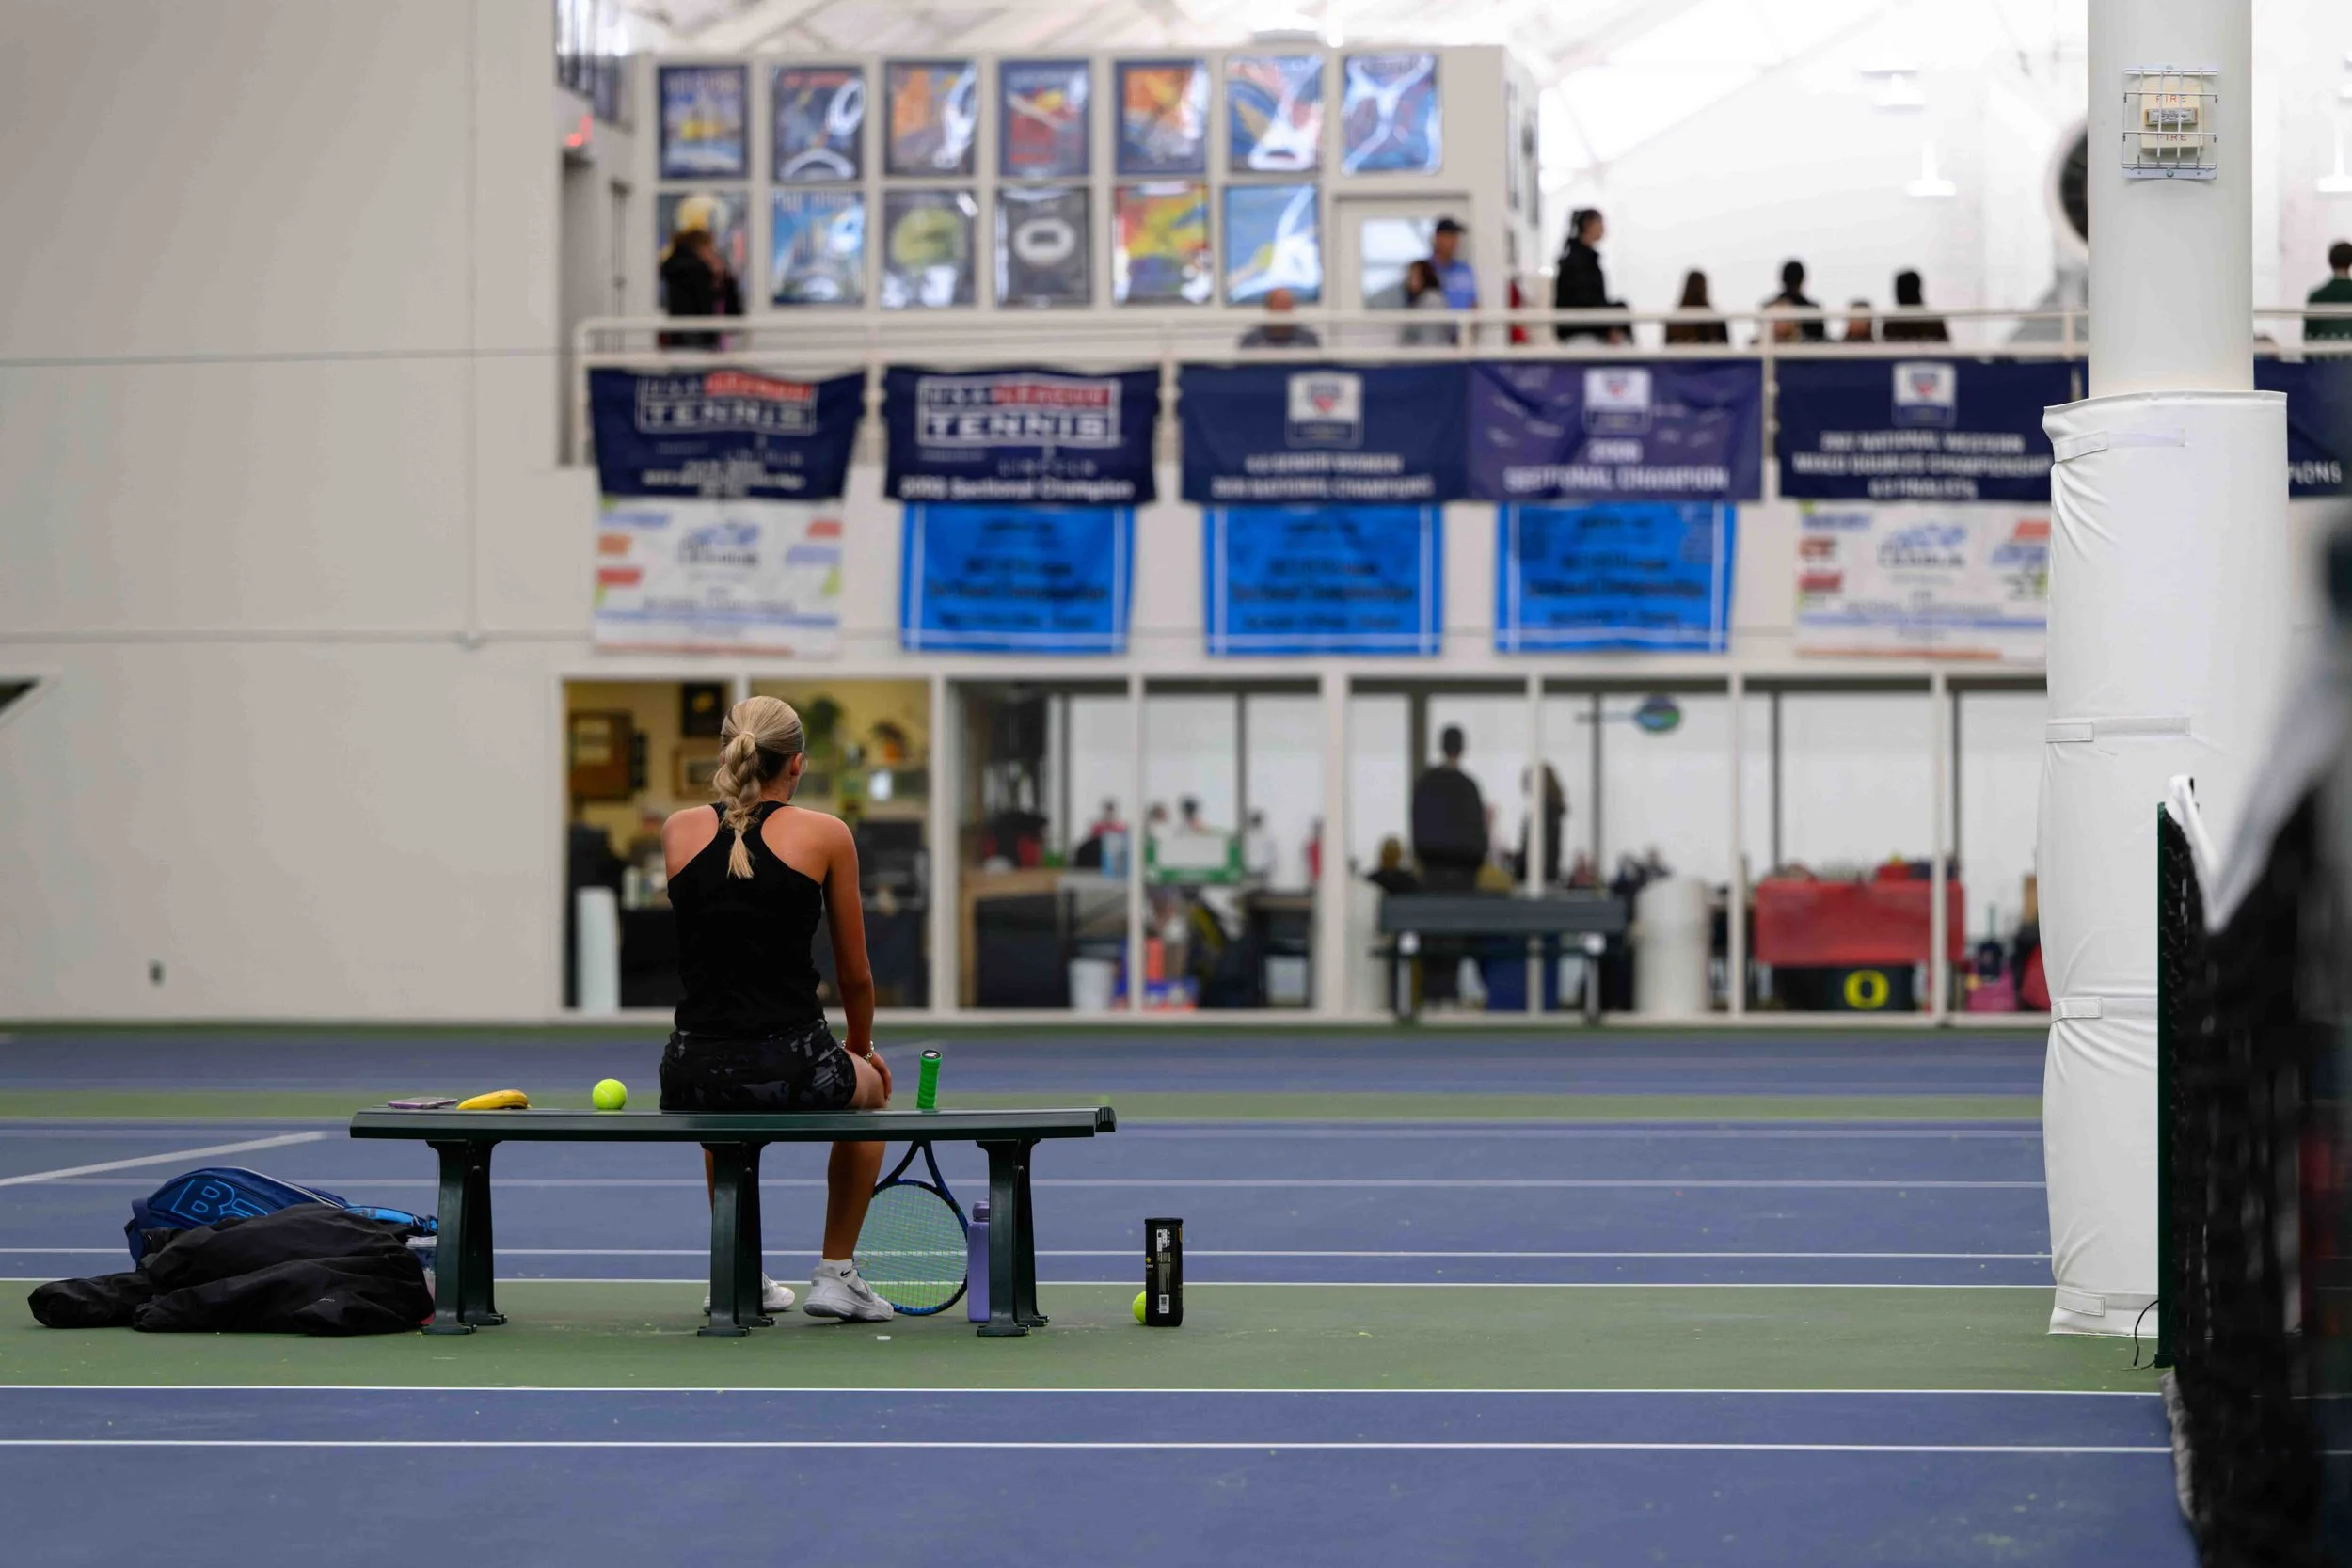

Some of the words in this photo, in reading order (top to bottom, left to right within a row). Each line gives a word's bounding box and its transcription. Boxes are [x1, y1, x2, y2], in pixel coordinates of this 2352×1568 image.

[646, 400, 805, 429] TENNIS
[927, 411, 1107, 441] TENNIS
[950, 476, 1035, 500] Sectional
[1039, 476, 1136, 502] Champion
[1503, 466, 1613, 493] SECTIONAL
[1616, 466, 1730, 491] CHAMPION
